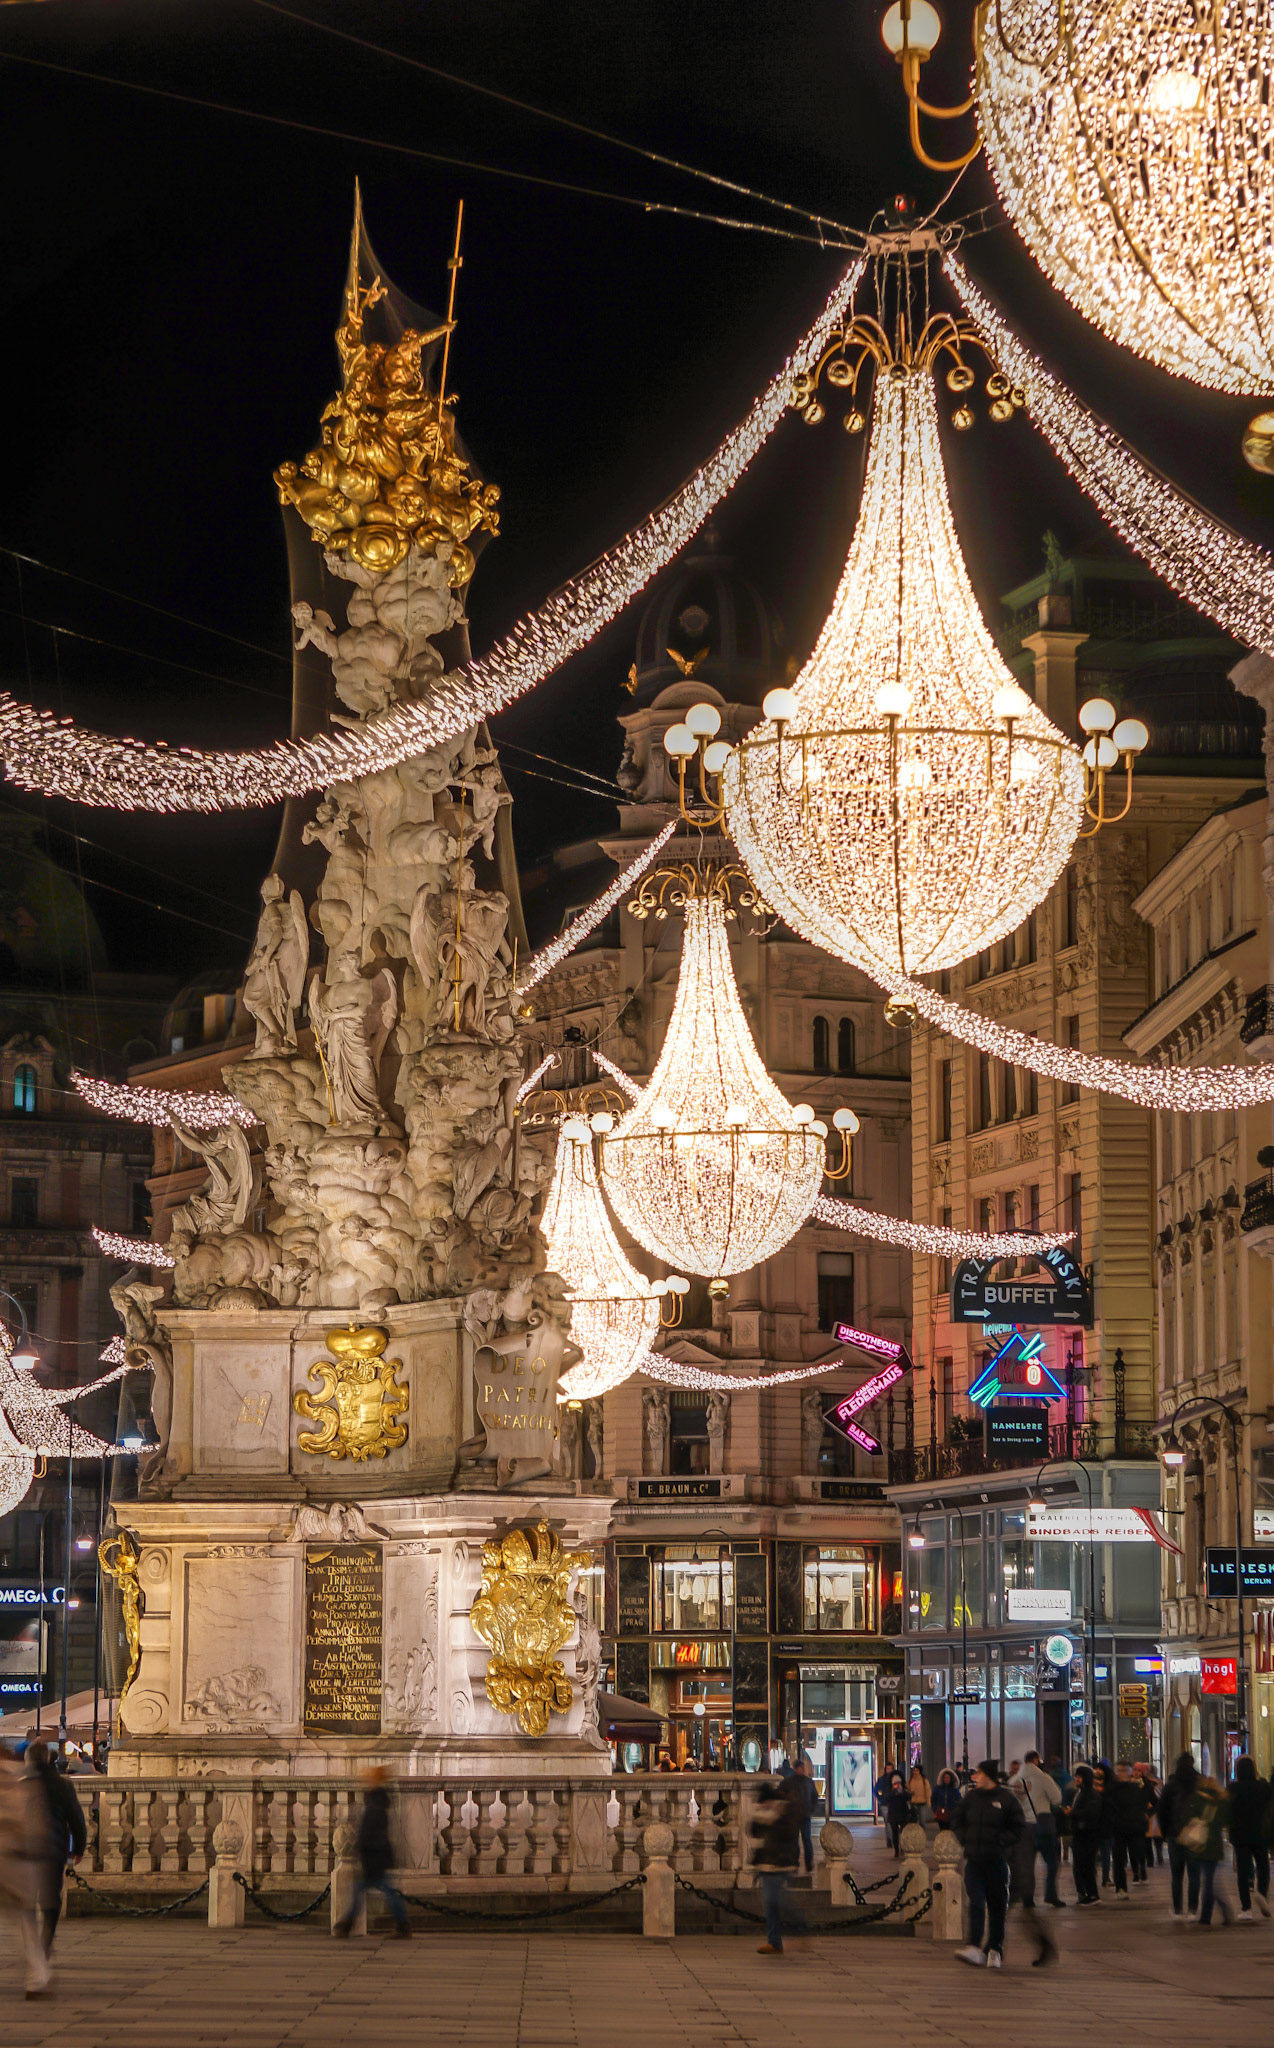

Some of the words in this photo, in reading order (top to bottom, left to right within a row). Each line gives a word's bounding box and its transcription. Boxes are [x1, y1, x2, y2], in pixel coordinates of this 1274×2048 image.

[984, 1286, 1058, 1304] BUFFET
[839, 1325, 901, 1354] DISCOTHEQUE
[490, 1353, 547, 1376] DEO
[484, 1384, 549, 1403] PATRI
[837, 1366, 904, 1421] FLEDERMAUS
[855, 1376, 878, 1398] CABARET
[482, 1413, 552, 1430] CREATORI
[992, 1422, 1043, 1431] HANNELORE
[848, 1423, 867, 1441] BAR
[658, 1483, 690, 1494] BRAUN
[1029, 1528, 1100, 1536] SINDBADS
[1105, 1528, 1153, 1536] REISEN
[1244, 1577, 1272, 1585] BERLIN
[625, 1618, 643, 1627] PRAG
[0, 1683, 32, 1692] OMEGA
